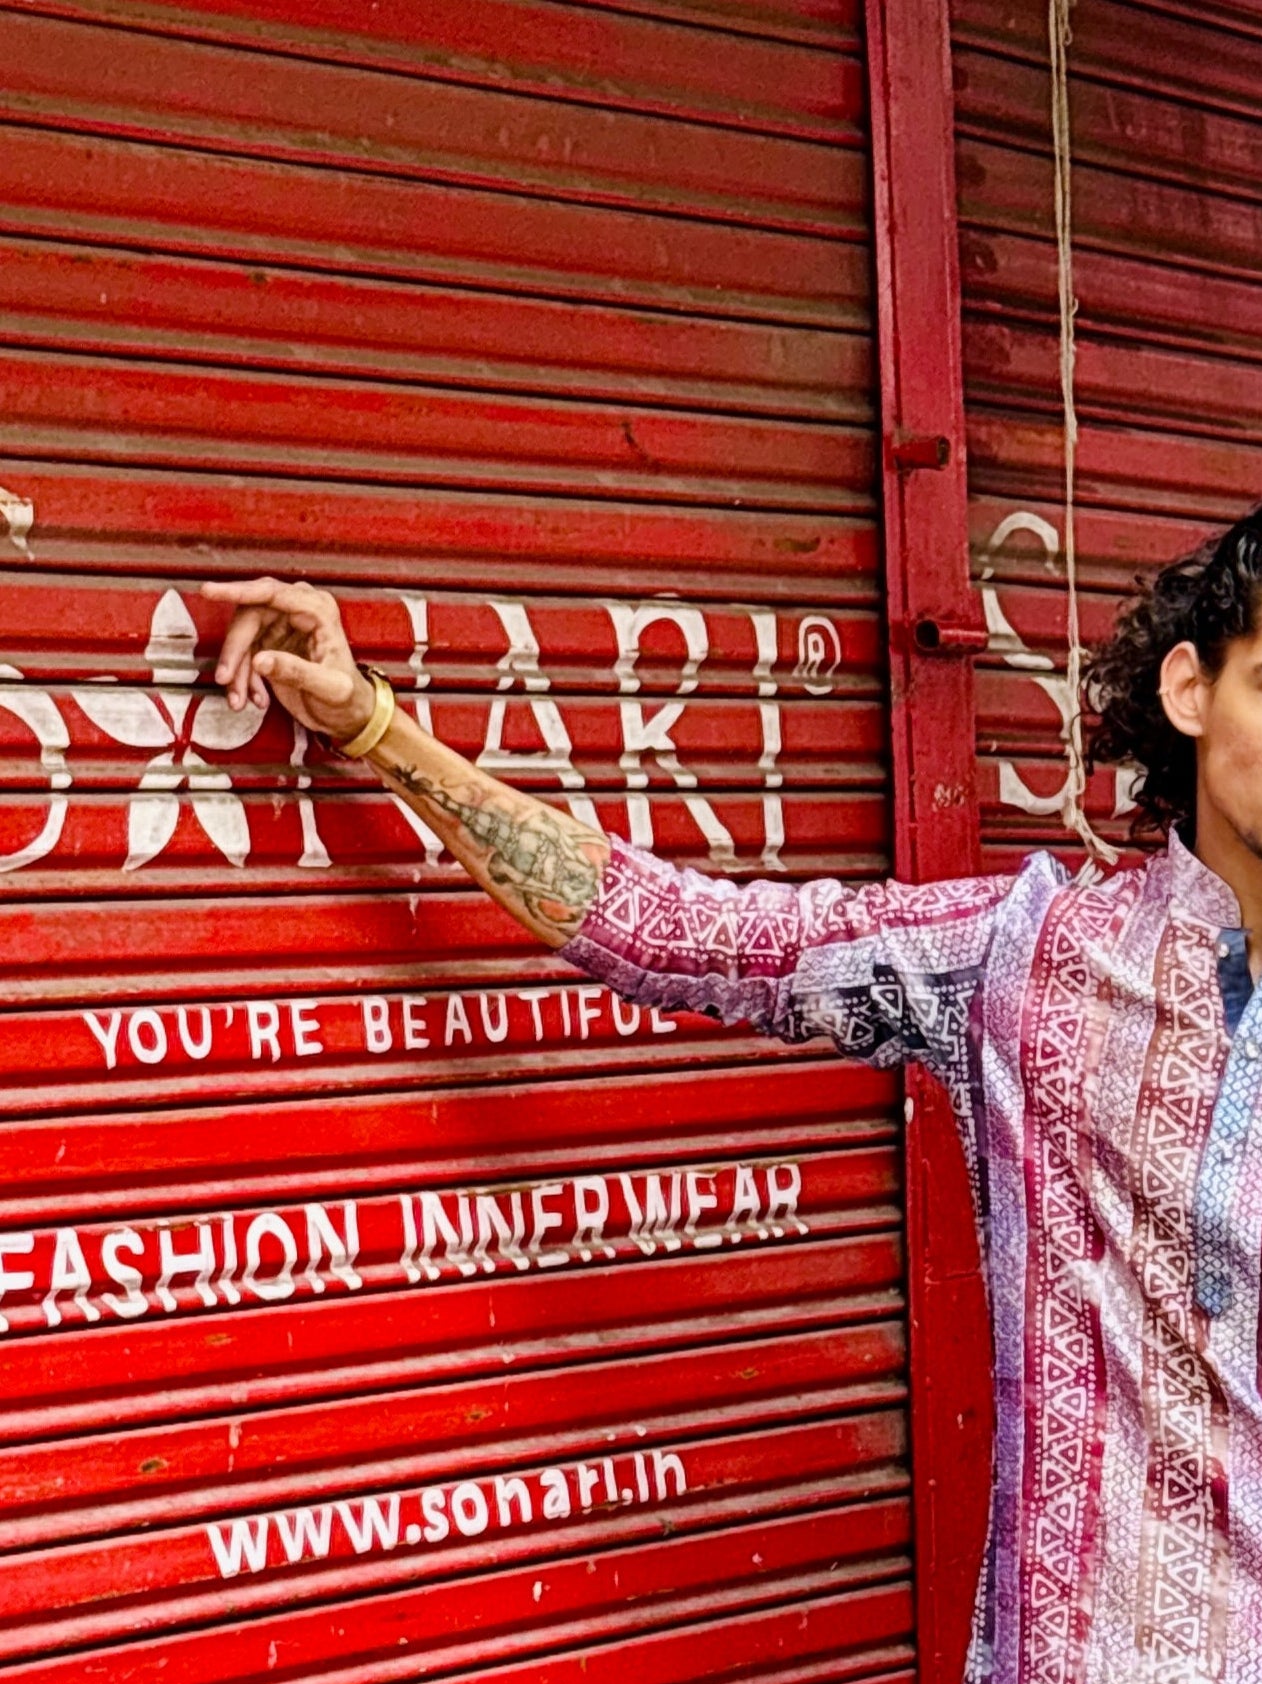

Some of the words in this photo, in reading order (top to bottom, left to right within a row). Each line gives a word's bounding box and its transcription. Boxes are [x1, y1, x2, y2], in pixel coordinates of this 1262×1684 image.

[82, 1000, 324, 1070] YOU'RE
[362, 988, 678, 1054] BEAUTIFUL
[399, 1163, 810, 1284] INNERWEAR
